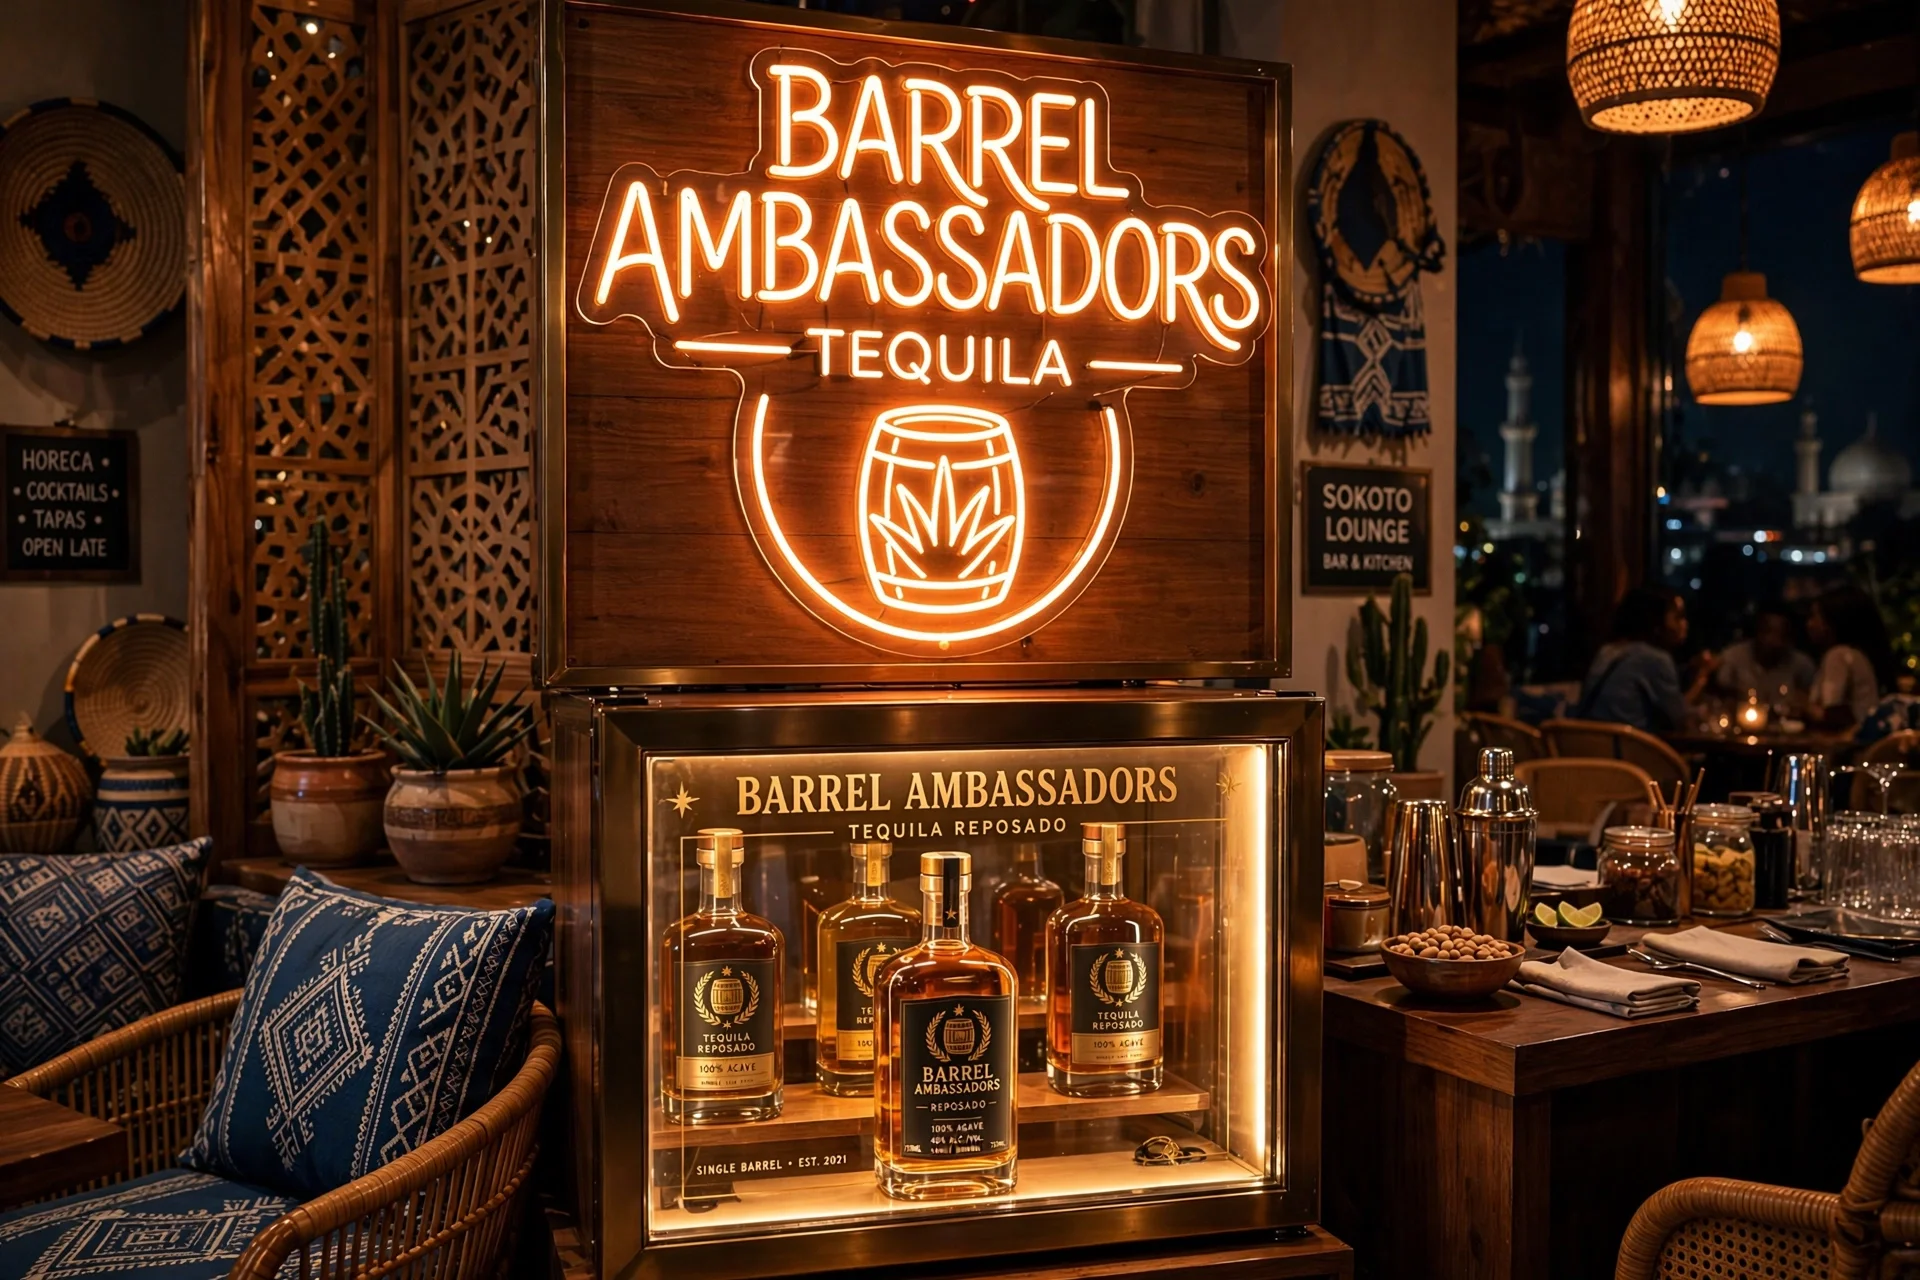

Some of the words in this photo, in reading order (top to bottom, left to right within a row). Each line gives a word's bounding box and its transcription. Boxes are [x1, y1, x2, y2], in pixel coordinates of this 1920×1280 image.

[768, 63, 1131, 212] BARREL
[594, 180, 1262, 352] AMBASSADORS
[806, 328, 1073, 387] TEQUILA
[22, 449, 94, 472] HORECA
[26, 481, 108, 502] COCKTAILS
[1322, 483, 1412, 513] SOKOTO
[33, 509, 86, 530] TAPAS
[1325, 516, 1409, 544] LOUNGE
[22, 537, 64, 557] OPEN
[70, 538, 107, 557] LATE
[1323, 552, 1348, 570] BAR
[1363, 553, 1413, 571] KITCHEN
[736, 773, 891, 816] BARREL
[903, 765, 1178, 811] AMBASSADORS
[849, 821, 943, 841] TEQUILA
[954, 817, 1066, 836] REPOSADO
[1092, 1019, 1144, 1030] REPOSADO
[1098, 1010, 1139, 1020] TEQUILA
[703, 1032, 750, 1043] TEQUILA
[697, 1043, 755, 1053] REPOSADO
[700, 1065, 723, 1073] 100%
[922, 1063, 994, 1083] BARREL
[914, 1078, 1000, 1095] AMBASSADORS
[930, 1099, 986, 1112] REPOSADO
[956, 1121, 985, 1132] AGAVE
[696, 1162, 736, 1176] SINGLE
[740, 1159, 783, 1172] BARREL
[798, 1156, 820, 1168] EST.
[823, 1154, 848, 1166] 2021
